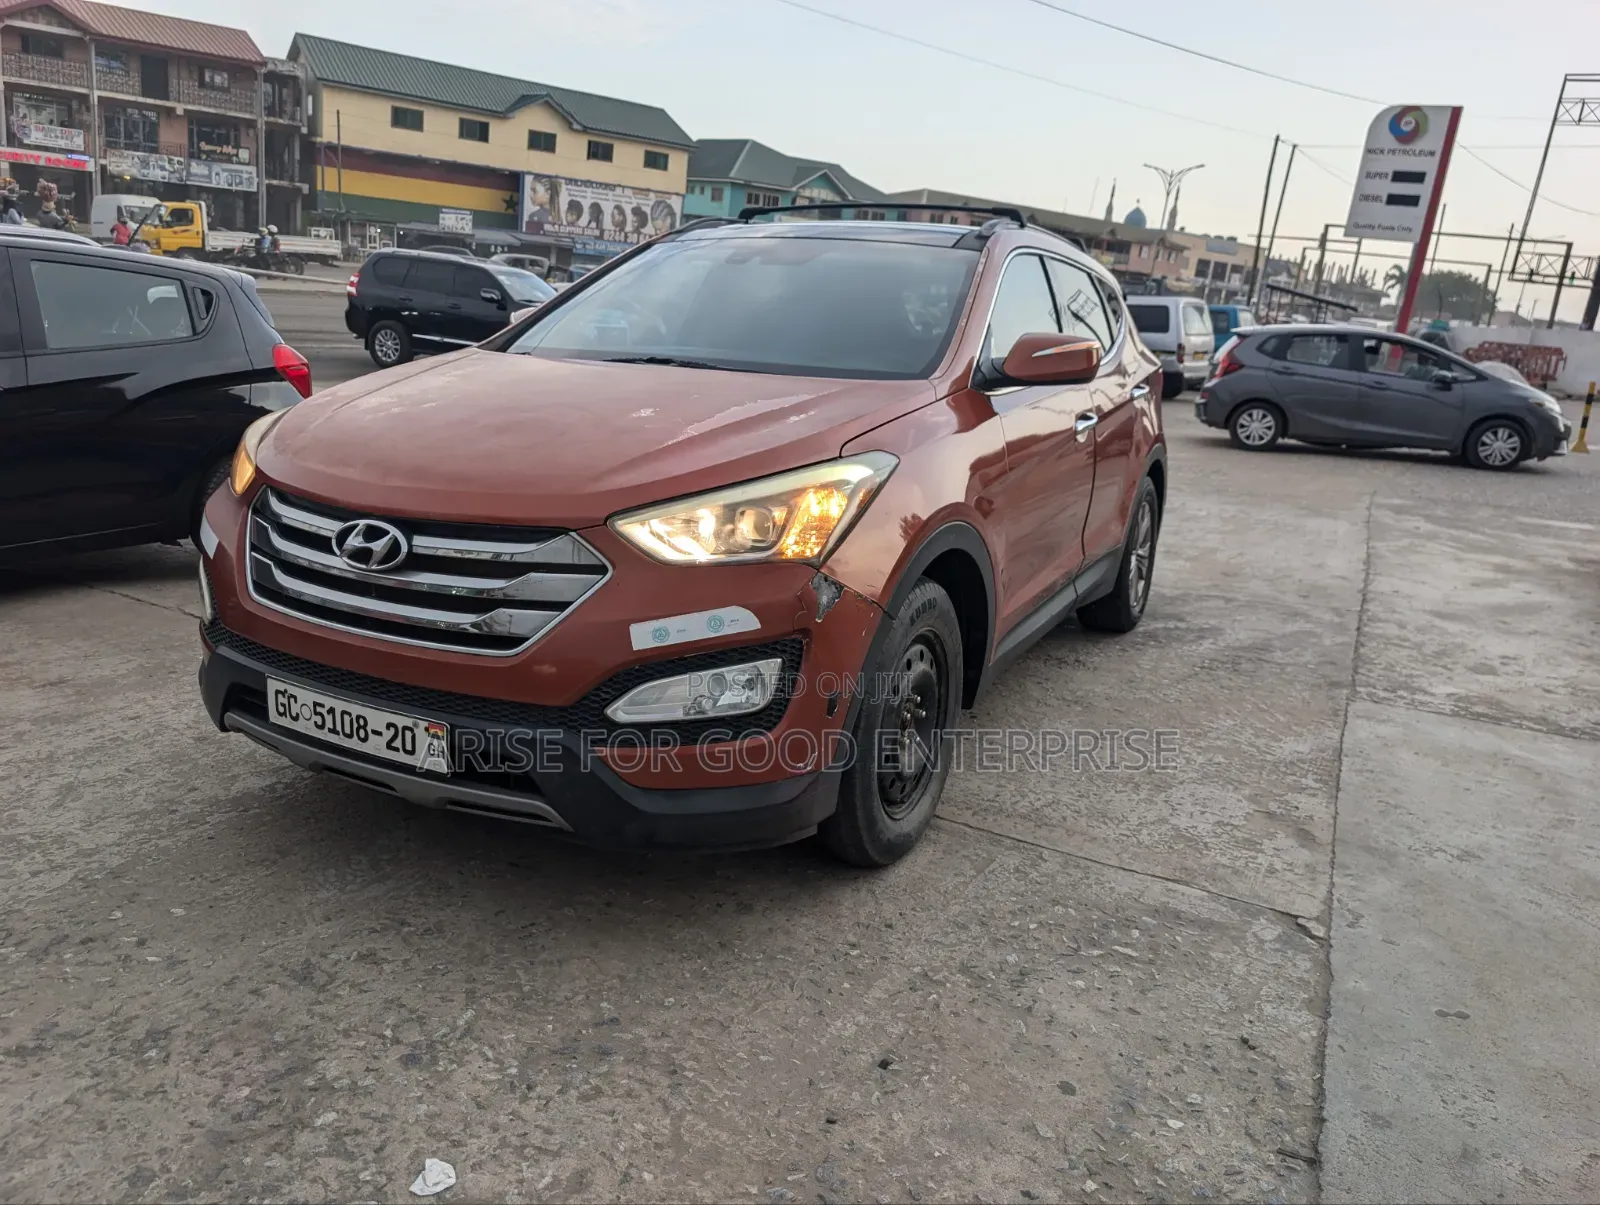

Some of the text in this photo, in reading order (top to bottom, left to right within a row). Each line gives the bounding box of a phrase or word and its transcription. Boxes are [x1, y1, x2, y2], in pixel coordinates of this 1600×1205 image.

[1387, 148, 1436, 158] PETROLEUM
[1364, 171, 1389, 180] SUPER
[1359, 194, 1383, 204] DIESEL
[1353, 222, 1375, 231] Quality
[274, 688, 416, 756] GC 5108-20
